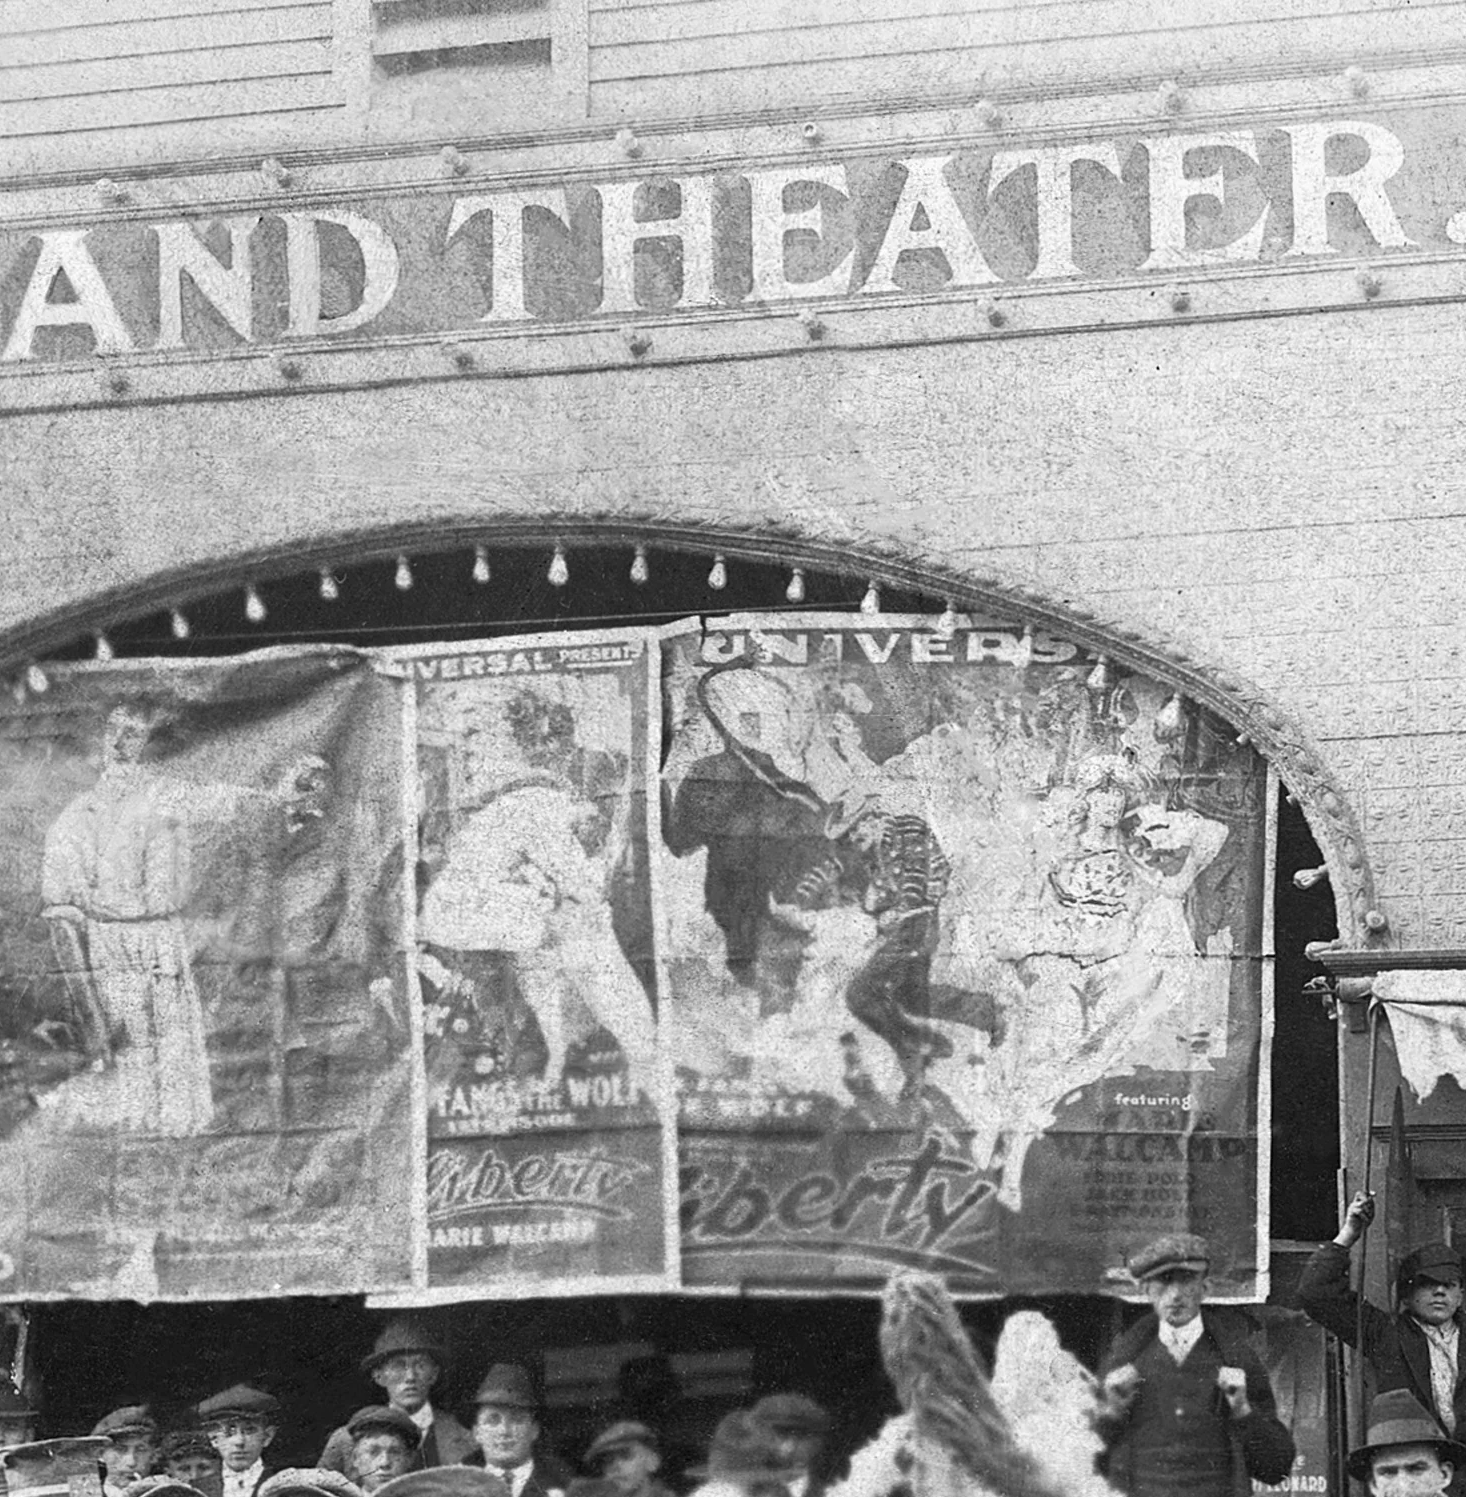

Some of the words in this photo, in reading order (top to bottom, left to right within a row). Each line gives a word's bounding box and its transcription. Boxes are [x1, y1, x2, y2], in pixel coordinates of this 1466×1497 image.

[700, 630, 1099, 665] UNIVERS
[1114, 1092, 1193, 1112] featuring
[427, 1226, 483, 1247] ARIE
